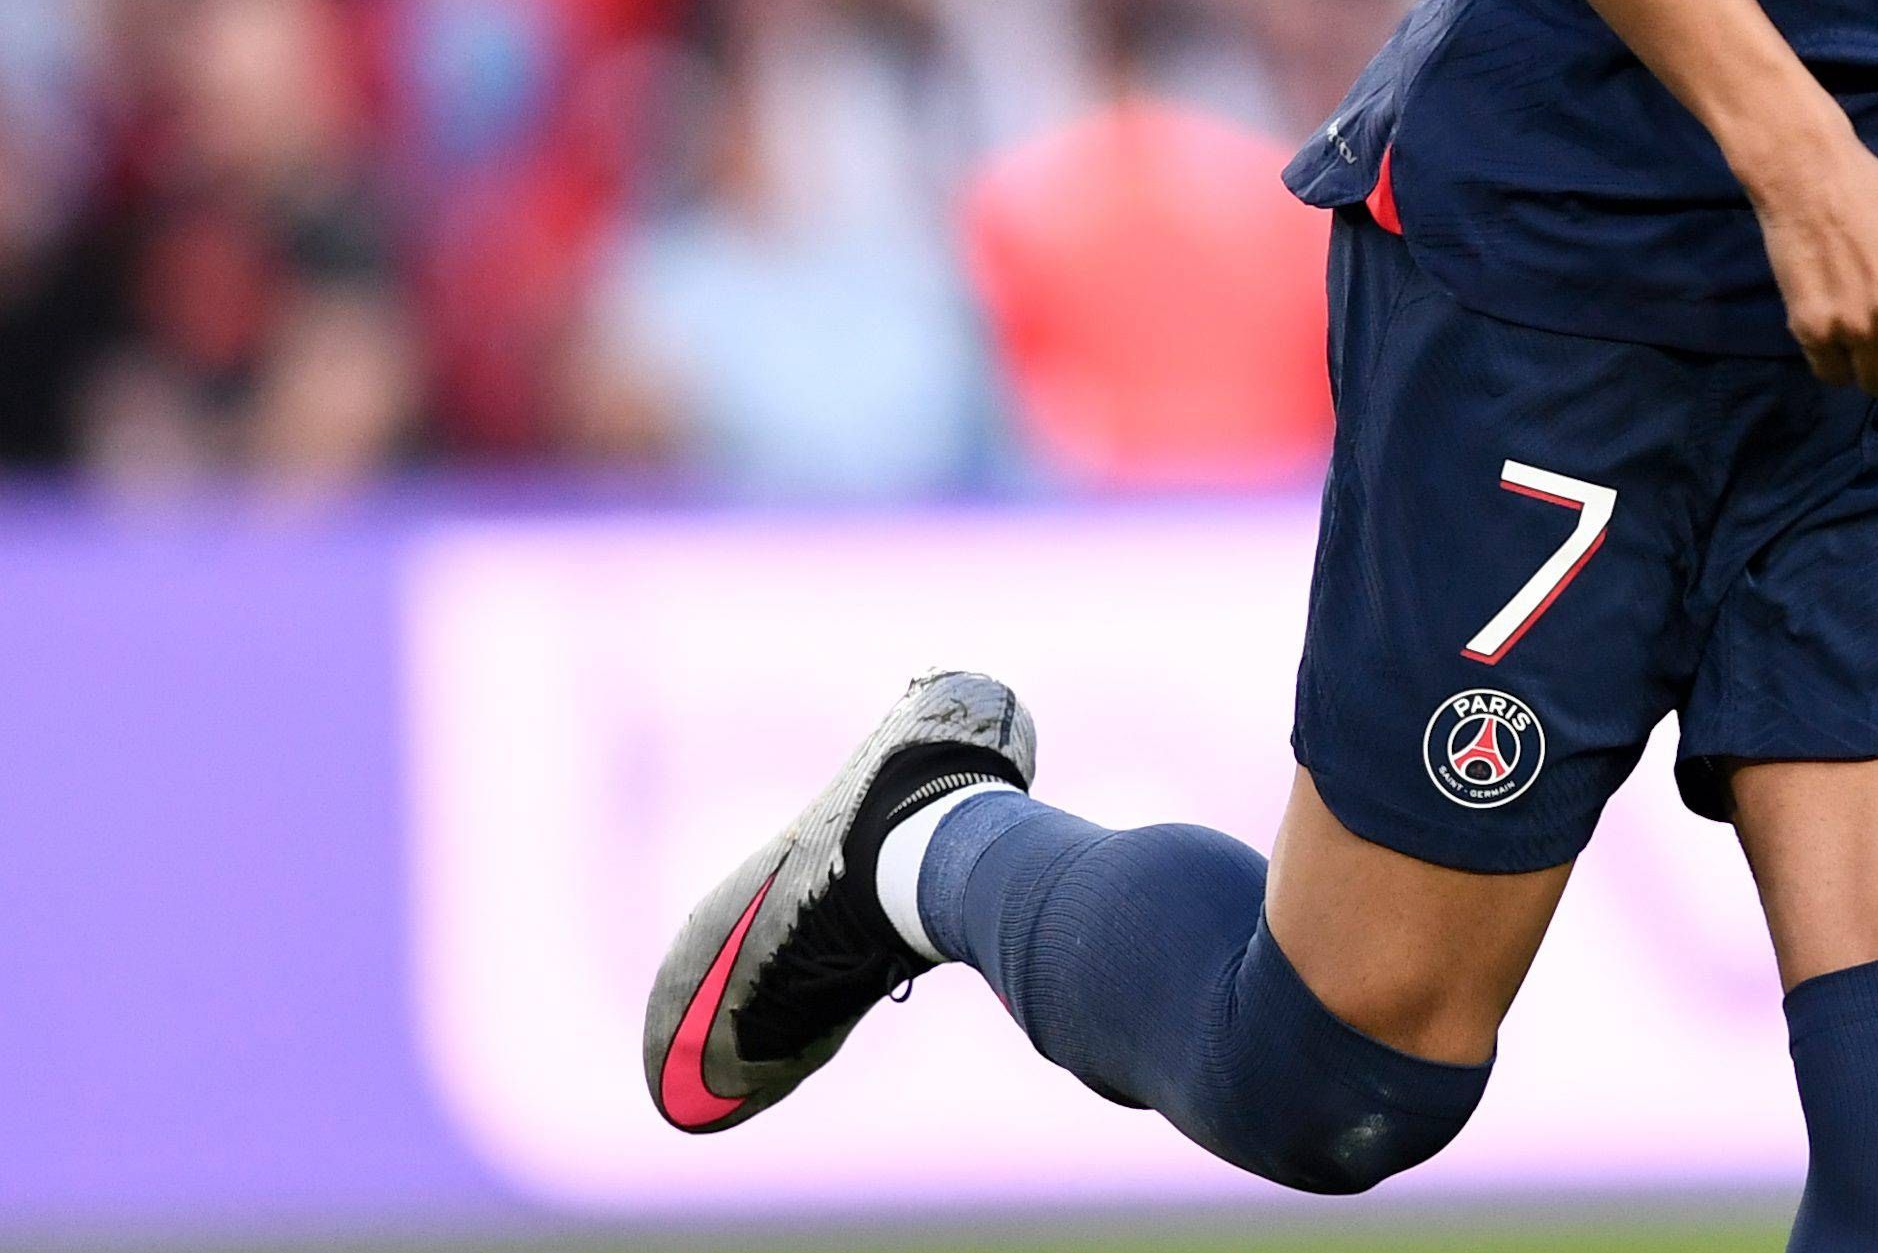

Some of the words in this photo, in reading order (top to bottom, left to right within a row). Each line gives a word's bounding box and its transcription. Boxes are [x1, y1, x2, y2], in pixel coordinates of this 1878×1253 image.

[1460, 458, 1618, 666] 7
[1453, 694, 1532, 732] PARIS
[1438, 764, 1464, 792] SAINT
[1469, 780, 1517, 799] GERMAIN
